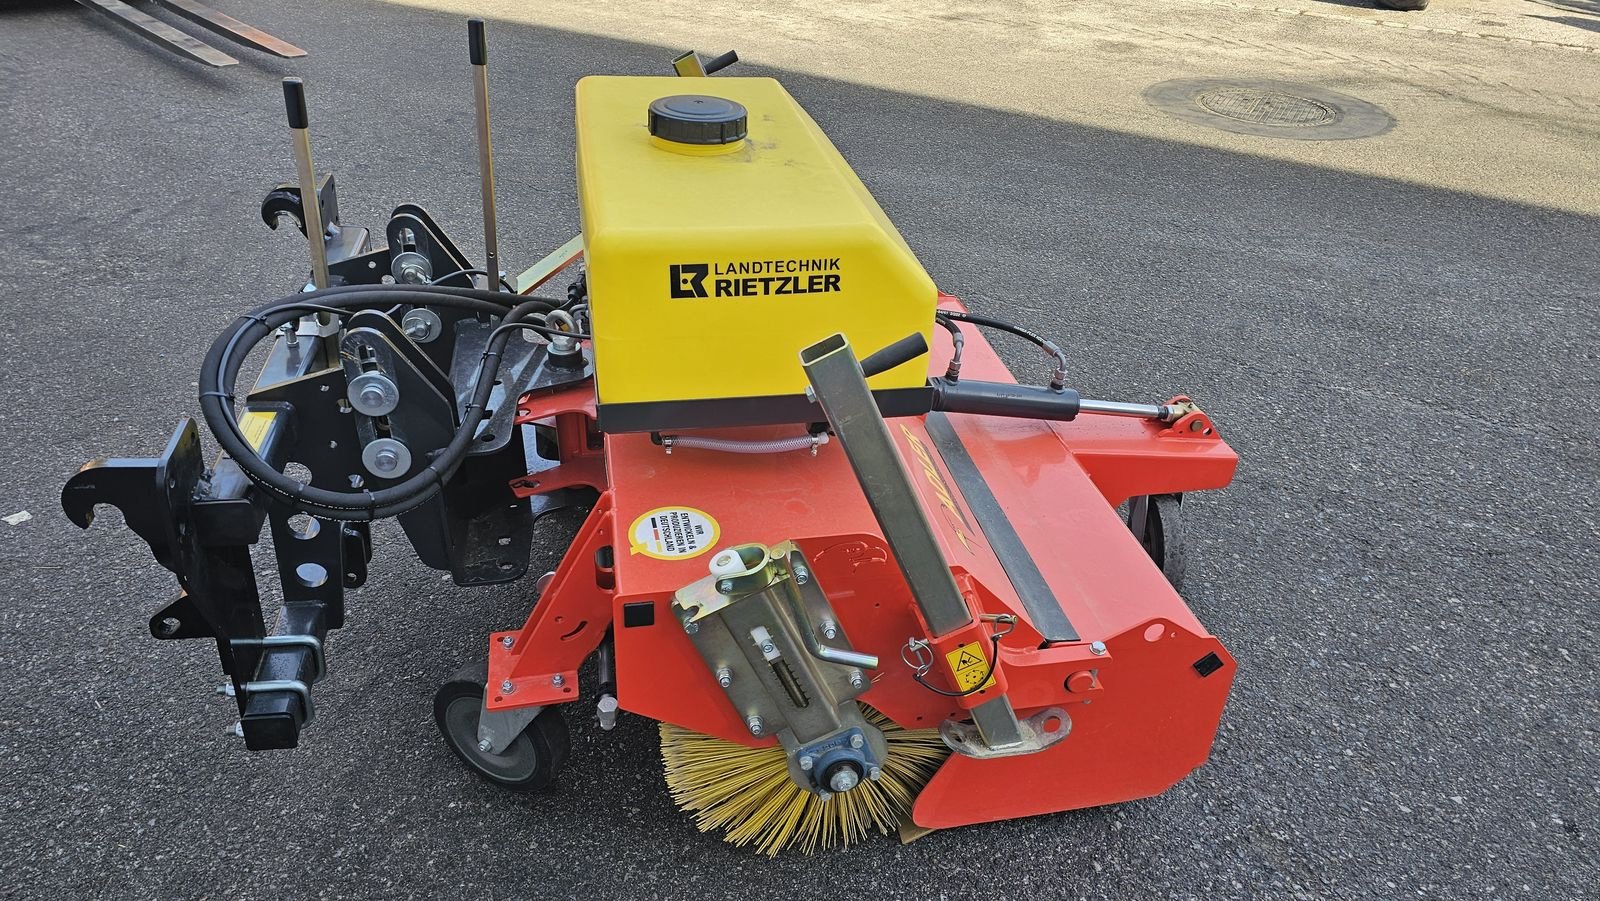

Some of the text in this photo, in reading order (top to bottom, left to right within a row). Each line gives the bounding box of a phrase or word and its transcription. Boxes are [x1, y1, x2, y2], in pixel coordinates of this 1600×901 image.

[714, 258, 841, 275] LANDTECHNIK
[715, 274, 841, 298] RIETZLER
[660, 515, 675, 552] DEUTSCHLAND
[670, 511, 685, 547] PRODUZIEREN
[680, 512, 696, 545] ENTWICKELN
[694, 524, 704, 535] WIR
